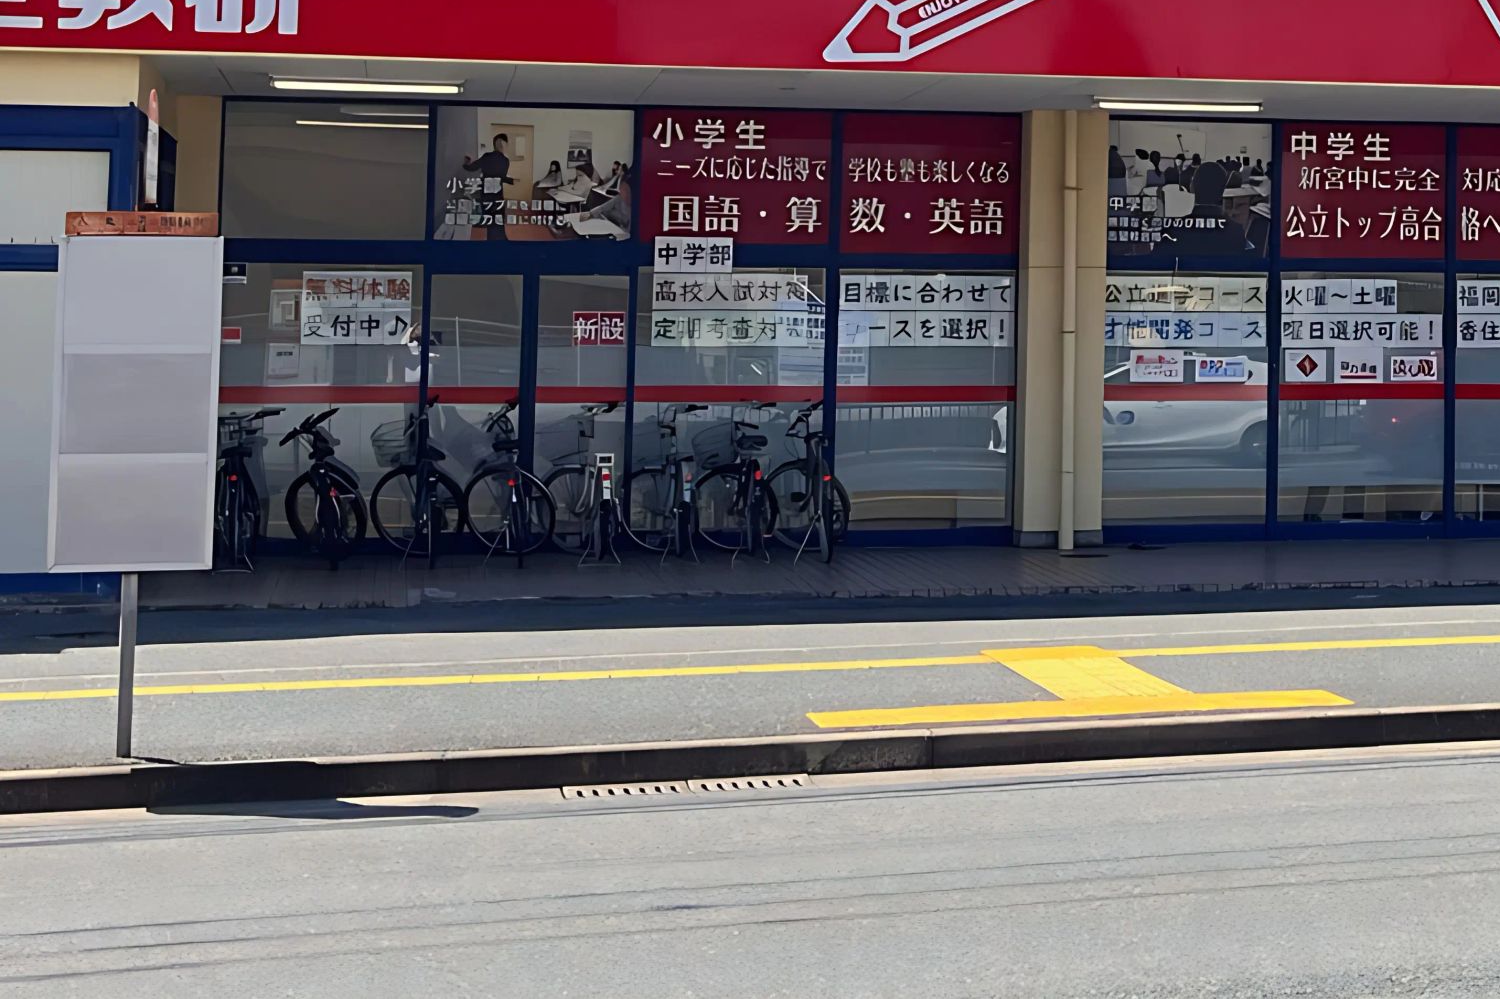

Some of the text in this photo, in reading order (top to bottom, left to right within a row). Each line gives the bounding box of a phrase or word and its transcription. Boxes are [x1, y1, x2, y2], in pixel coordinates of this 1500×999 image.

[653, 117, 766, 149] 小学生
[1291, 131, 1391, 161] 中学生
[446, 177, 502, 194] 小学
[1109, 197, 1158, 212] 中学
[658, 243, 731, 266] 中学部
[844, 281, 1012, 304] 目標に合わせて
[573, 316, 624, 340] 新設
